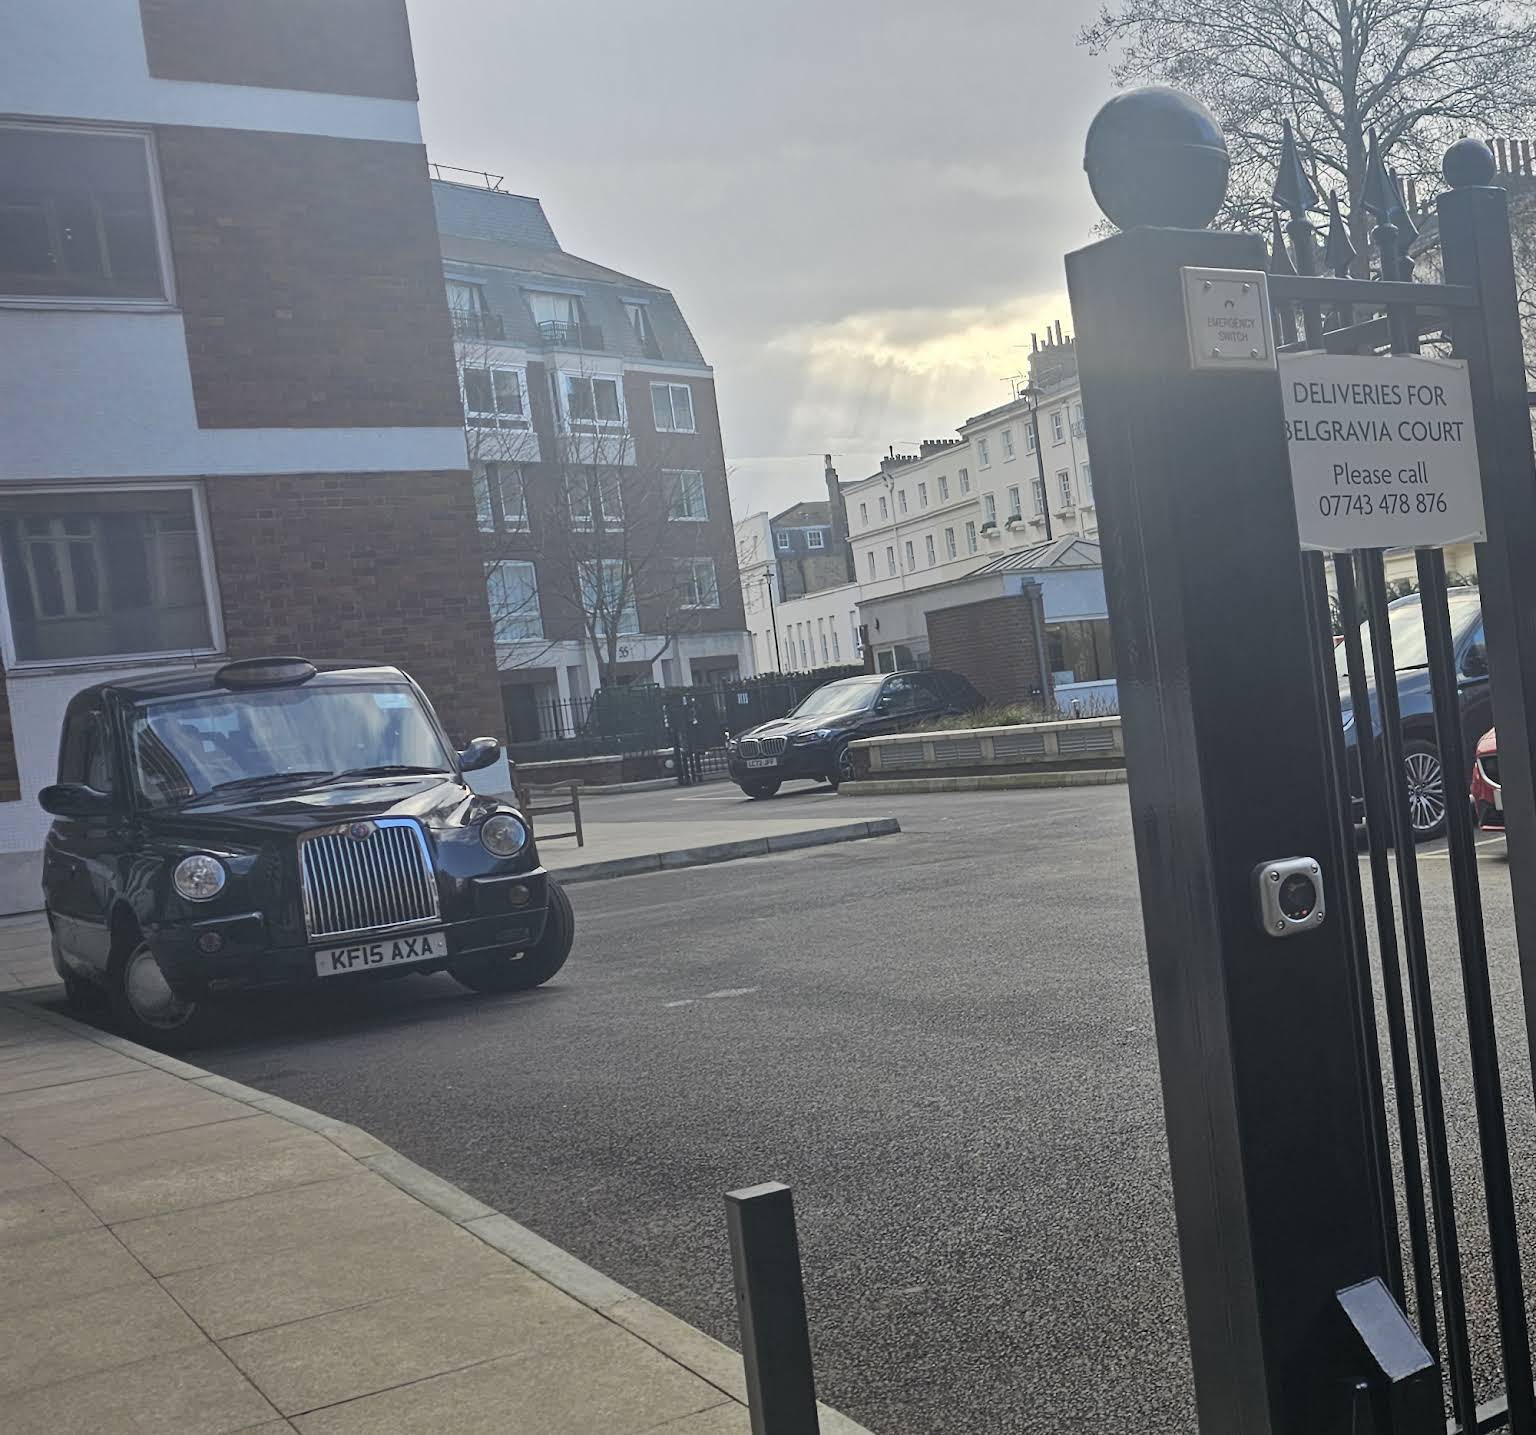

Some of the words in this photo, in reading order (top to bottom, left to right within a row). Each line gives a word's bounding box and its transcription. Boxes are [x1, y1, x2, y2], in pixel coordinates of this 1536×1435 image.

[1218, 331, 1248, 342] SWITCH
[1293, 382, 1402, 405] DELIVERIES
[1407, 385, 1447, 406] FOR
[1285, 420, 1393, 441] BELGRAVIA
[1398, 421, 1463, 441] COURT
[1333, 462, 1392, 485] Please
[1398, 461, 1428, 484] call
[1319, 494, 1373, 516] 07743
[1379, 493, 1410, 514] 478
[1416, 492, 1447, 513] 876
[331, 944, 384, 970] KF15
[391, 937, 433, 961] AXA
